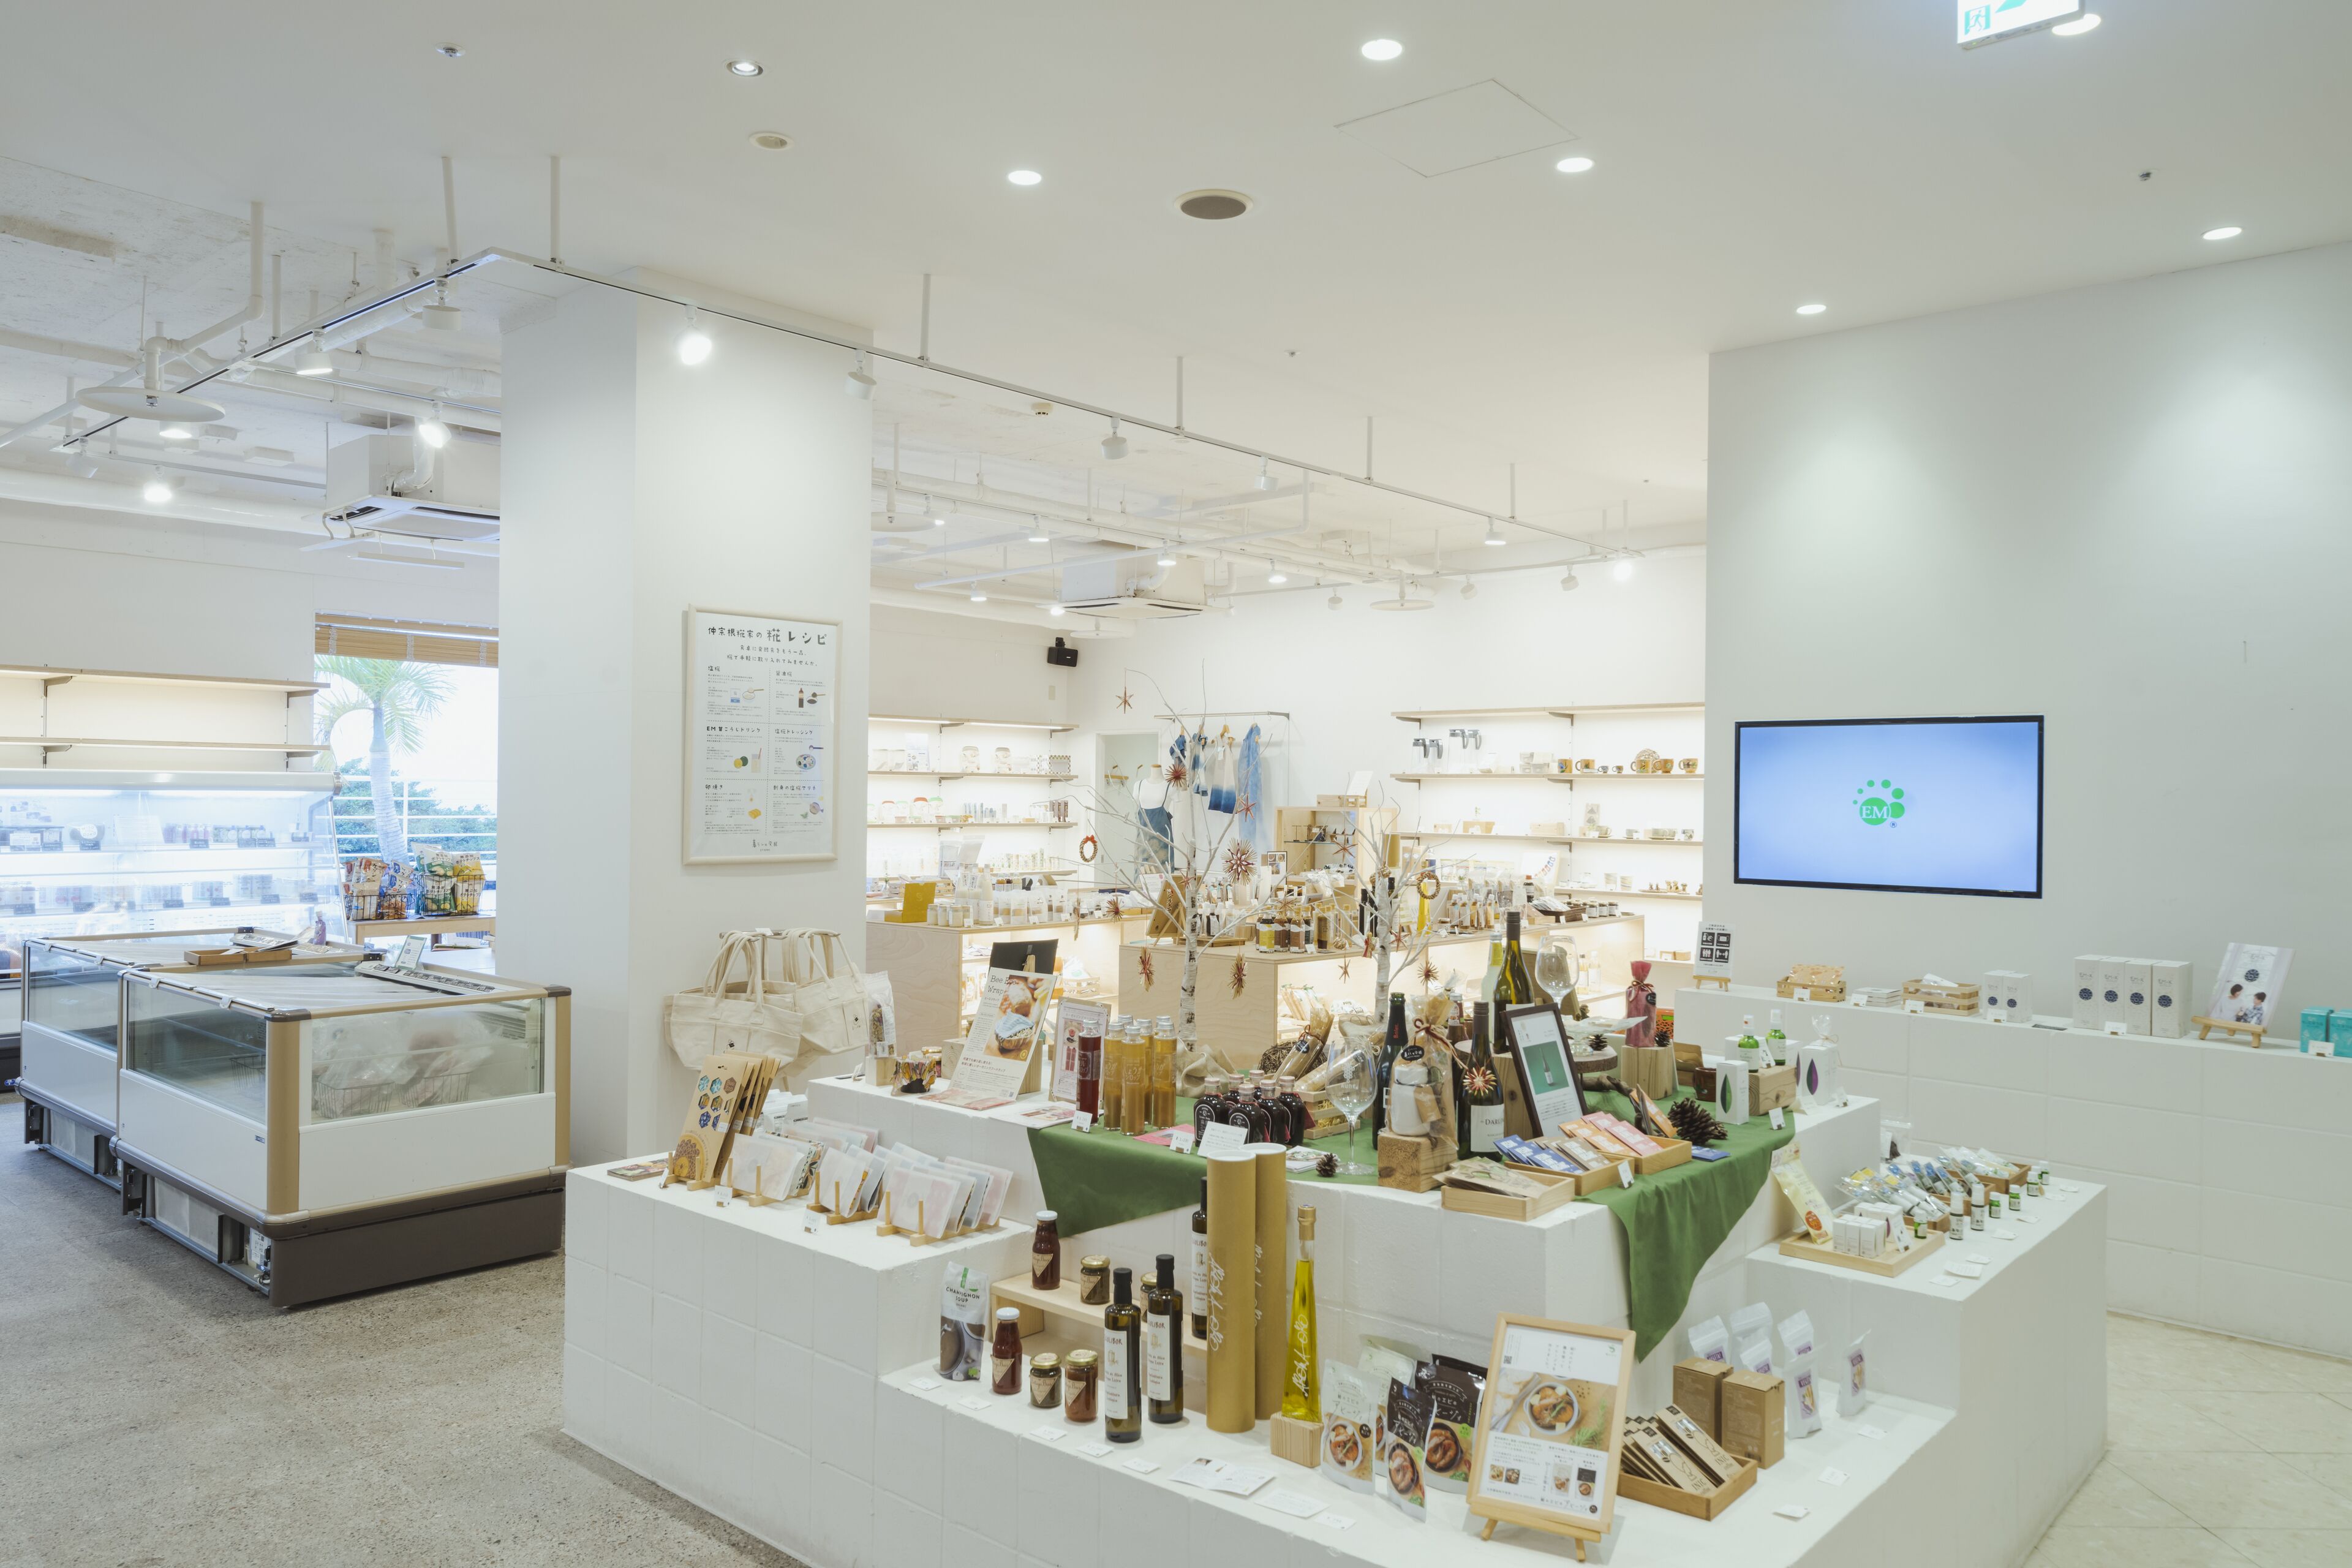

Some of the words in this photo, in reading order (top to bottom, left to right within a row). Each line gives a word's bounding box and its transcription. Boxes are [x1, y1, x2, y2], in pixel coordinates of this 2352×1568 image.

[1861, 805, 1889, 819] EM
[990, 974, 1003, 984] Bee
[1004, 977, 1020, 986] Eco
[987, 986, 1005, 996] Wrap
[1715, 1454, 1729, 1466] INIC
[1691, 1478, 1707, 1491] INIC
